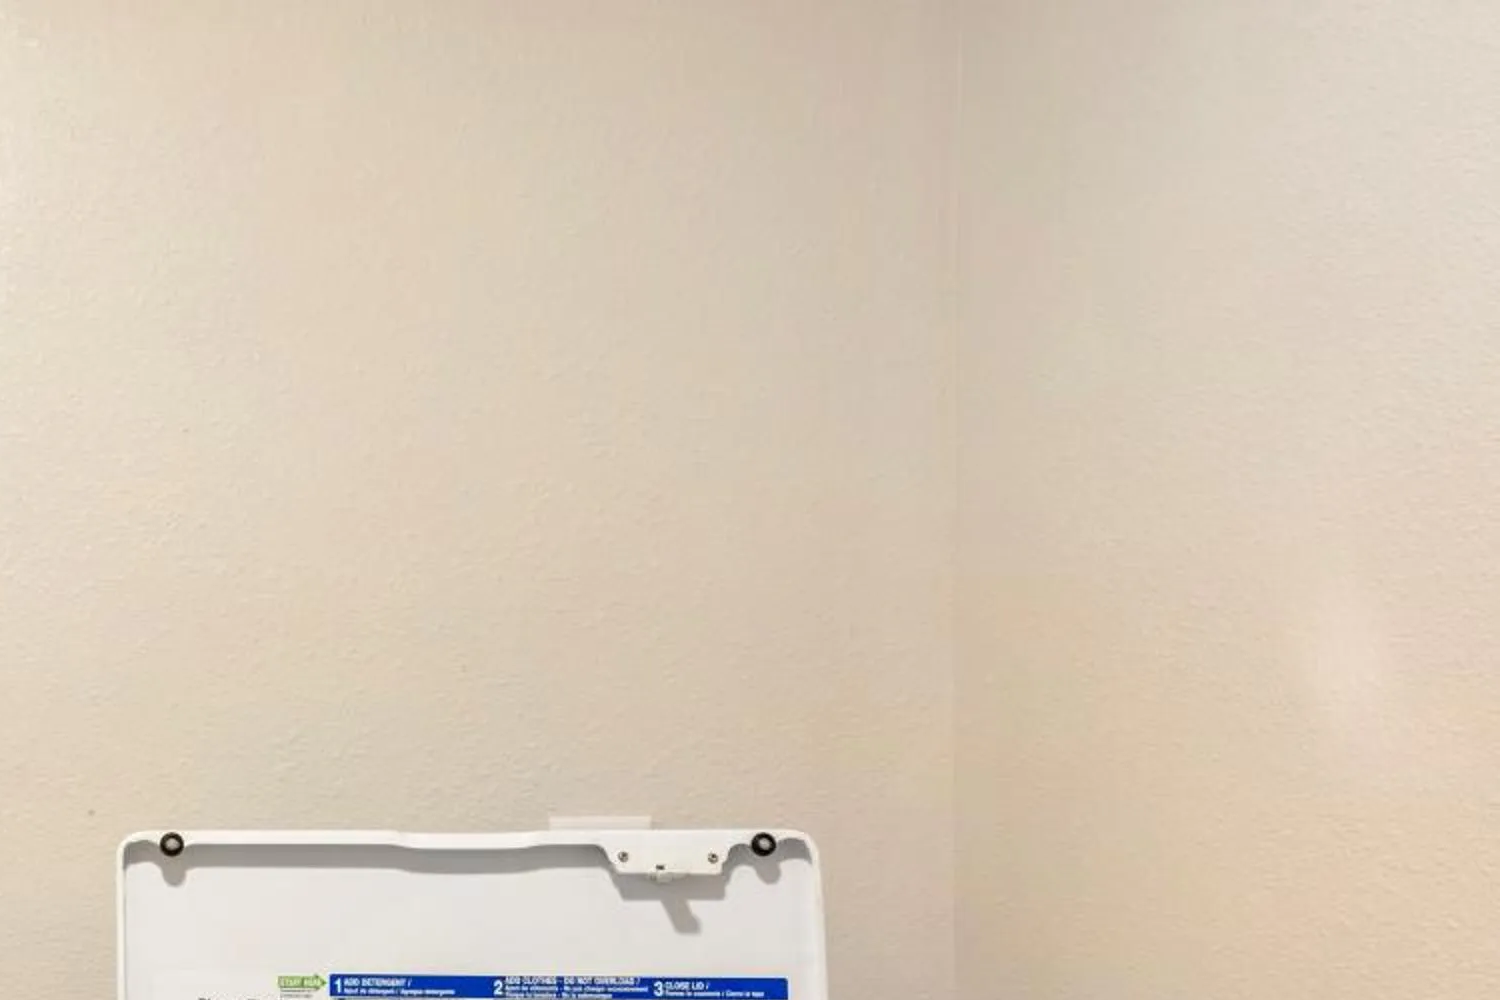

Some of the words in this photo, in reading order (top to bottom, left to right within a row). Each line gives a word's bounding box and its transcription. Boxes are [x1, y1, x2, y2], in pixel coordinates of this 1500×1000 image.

[334, 979, 342, 993] 1
[493, 981, 503, 995] 2
[654, 981, 663, 996] 3
[692, 982, 705, 990] LID
